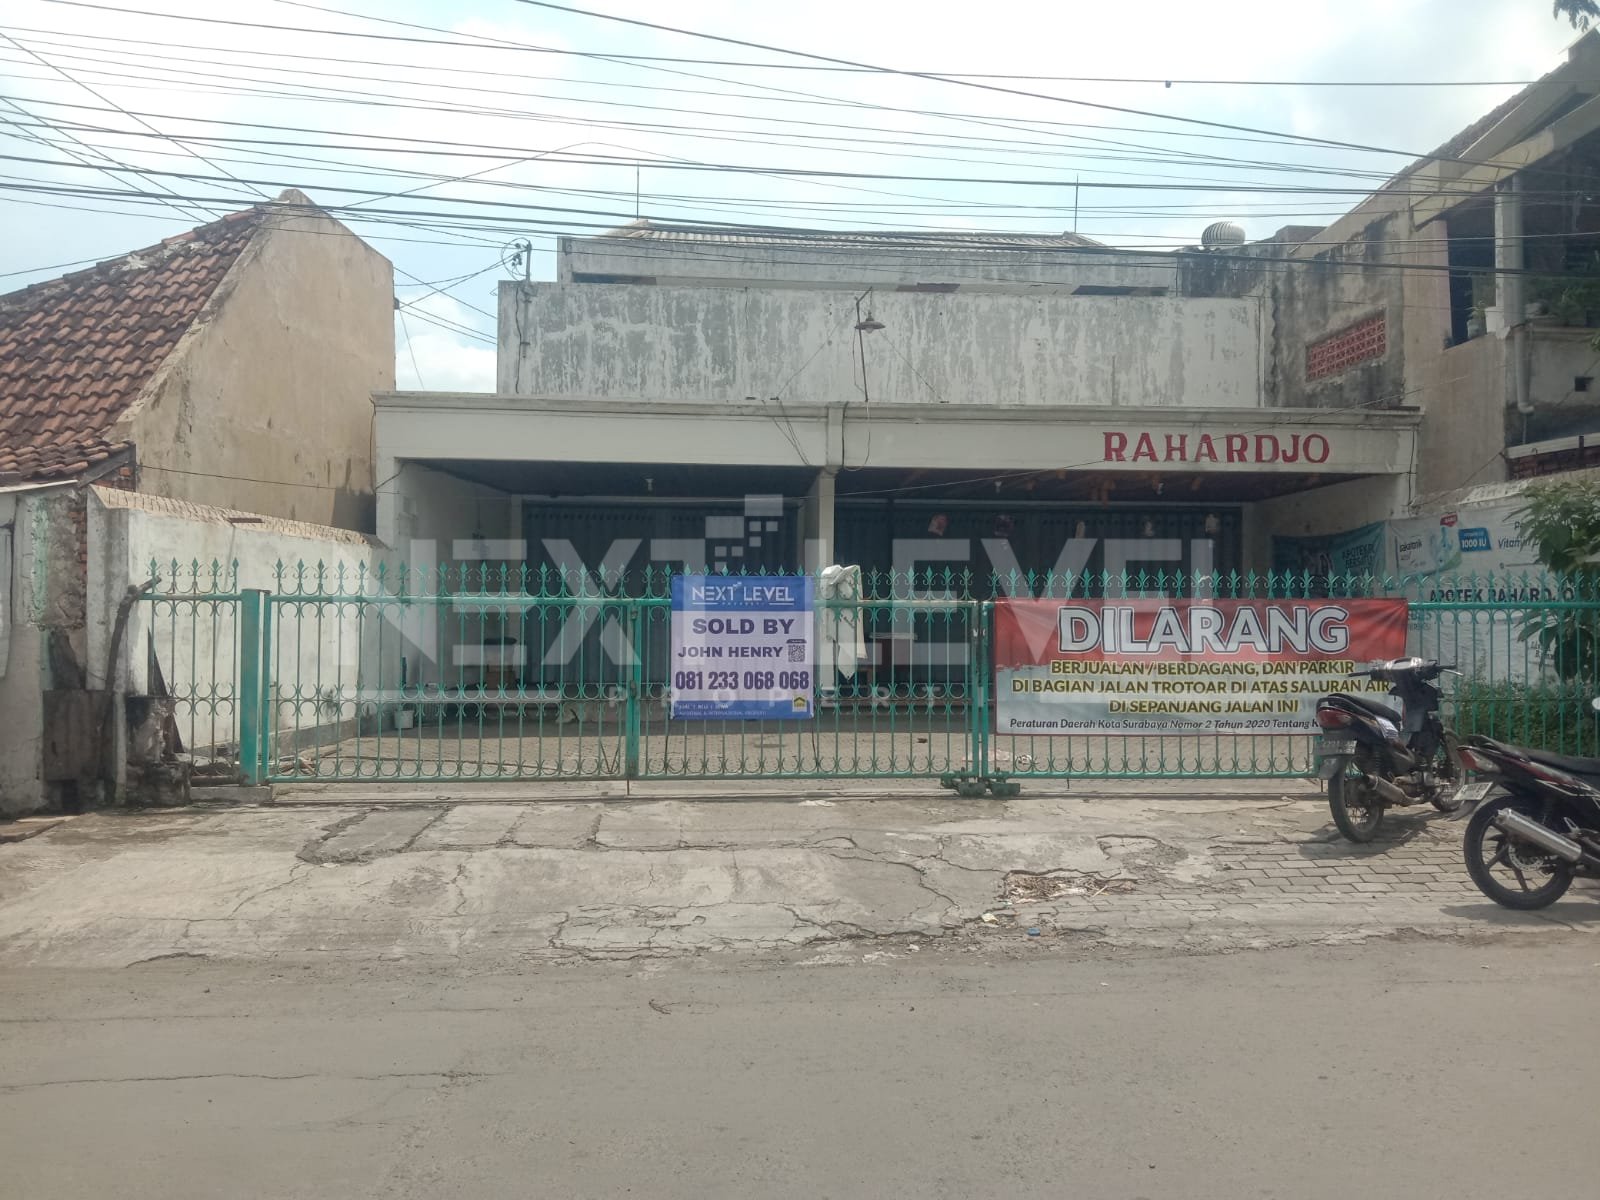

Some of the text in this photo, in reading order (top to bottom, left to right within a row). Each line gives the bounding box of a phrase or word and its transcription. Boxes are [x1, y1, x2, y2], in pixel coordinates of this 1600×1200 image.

[1103, 432, 1330, 463] RAHARDJO
[1461, 539, 1477, 549] 1000
[692, 586, 794, 601] NEXT LEVEL
[692, 619, 795, 634] SOLD BY
[1058, 605, 1351, 654] DILARANG
[678, 646, 783, 658] JOHN HENRY
[1051, 661, 1144, 675] BERJUALAN
[1157, 662, 1259, 677] BERDAGANG,
[1262, 662, 1298, 675] DAN
[1300, 661, 1354, 674] PARKIR
[675, 671, 809, 690] 081 233 068 068
[1012, 679, 1390, 694] DI BAGIAN JALAN TROTOAR DI ATAS SALURAN AIR
[1109, 700, 1298, 714] DI SEPANJANG JALAN INI
[1009, 718, 1058, 729] Peraturan
[1060, 718, 1096, 729] Daerah
[1098, 719, 1121, 729] Kota
[1122, 719, 1168, 730] Surabaya
[1170, 719, 1203, 729] Nomor
[1205, 719, 1212, 729] 2
[1214, 719, 1243, 729] Tahun
[1245, 719, 1270, 729] 2020
[1272, 719, 1310, 730] Tentang
